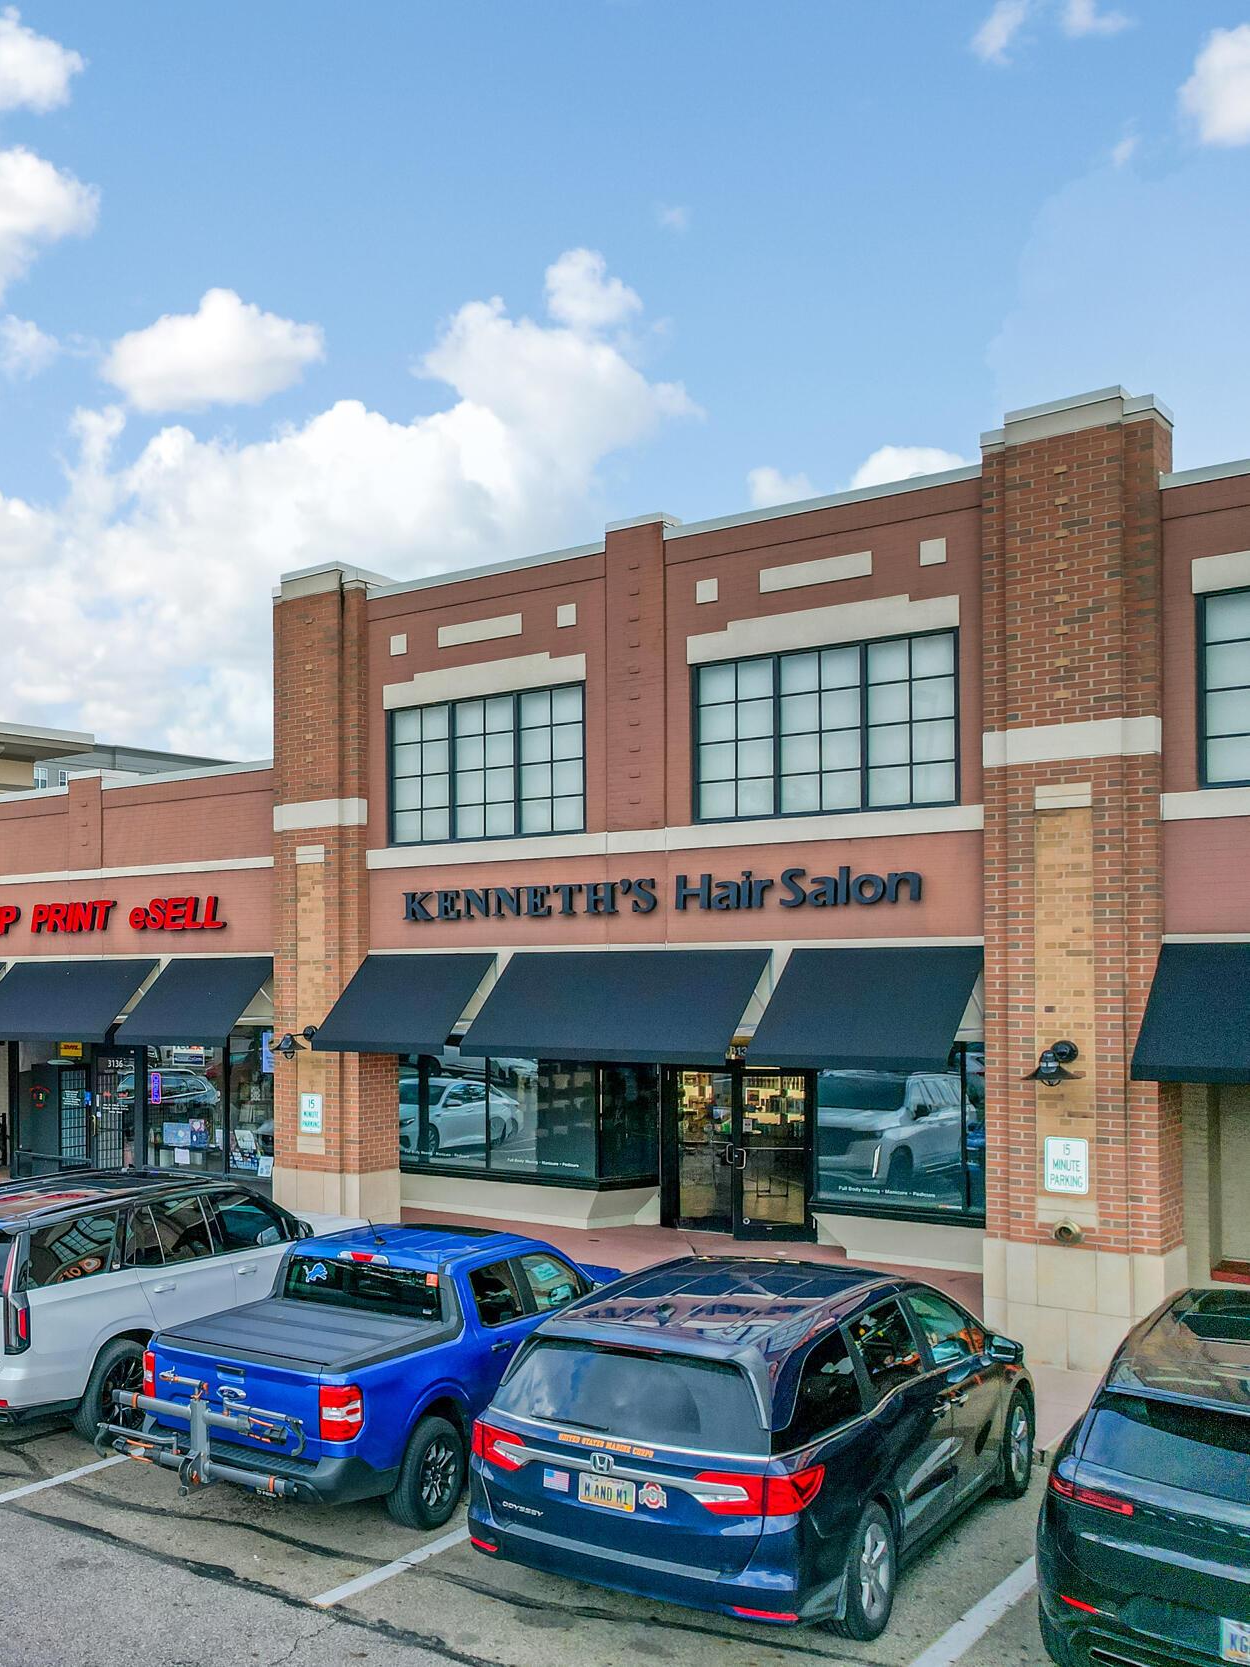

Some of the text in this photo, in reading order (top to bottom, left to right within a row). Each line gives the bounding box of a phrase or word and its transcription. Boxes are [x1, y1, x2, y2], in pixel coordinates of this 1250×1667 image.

[402, 866, 922, 921] KENNETH'S Hair Salon
[31, 900, 117, 933] PRINT
[129, 896, 227, 930] eSELL
[108, 1060, 123, 1068] 3136
[309, 1099, 315, 1109] 15
[1063, 1144, 1070, 1155] 15
[1053, 1159, 1081, 1172] MINUTE
[1050, 1174, 1083, 1188] PARKING
[594, 1484, 613, 1502] AND
[502, 1500, 543, 1517] ODYSSEY
